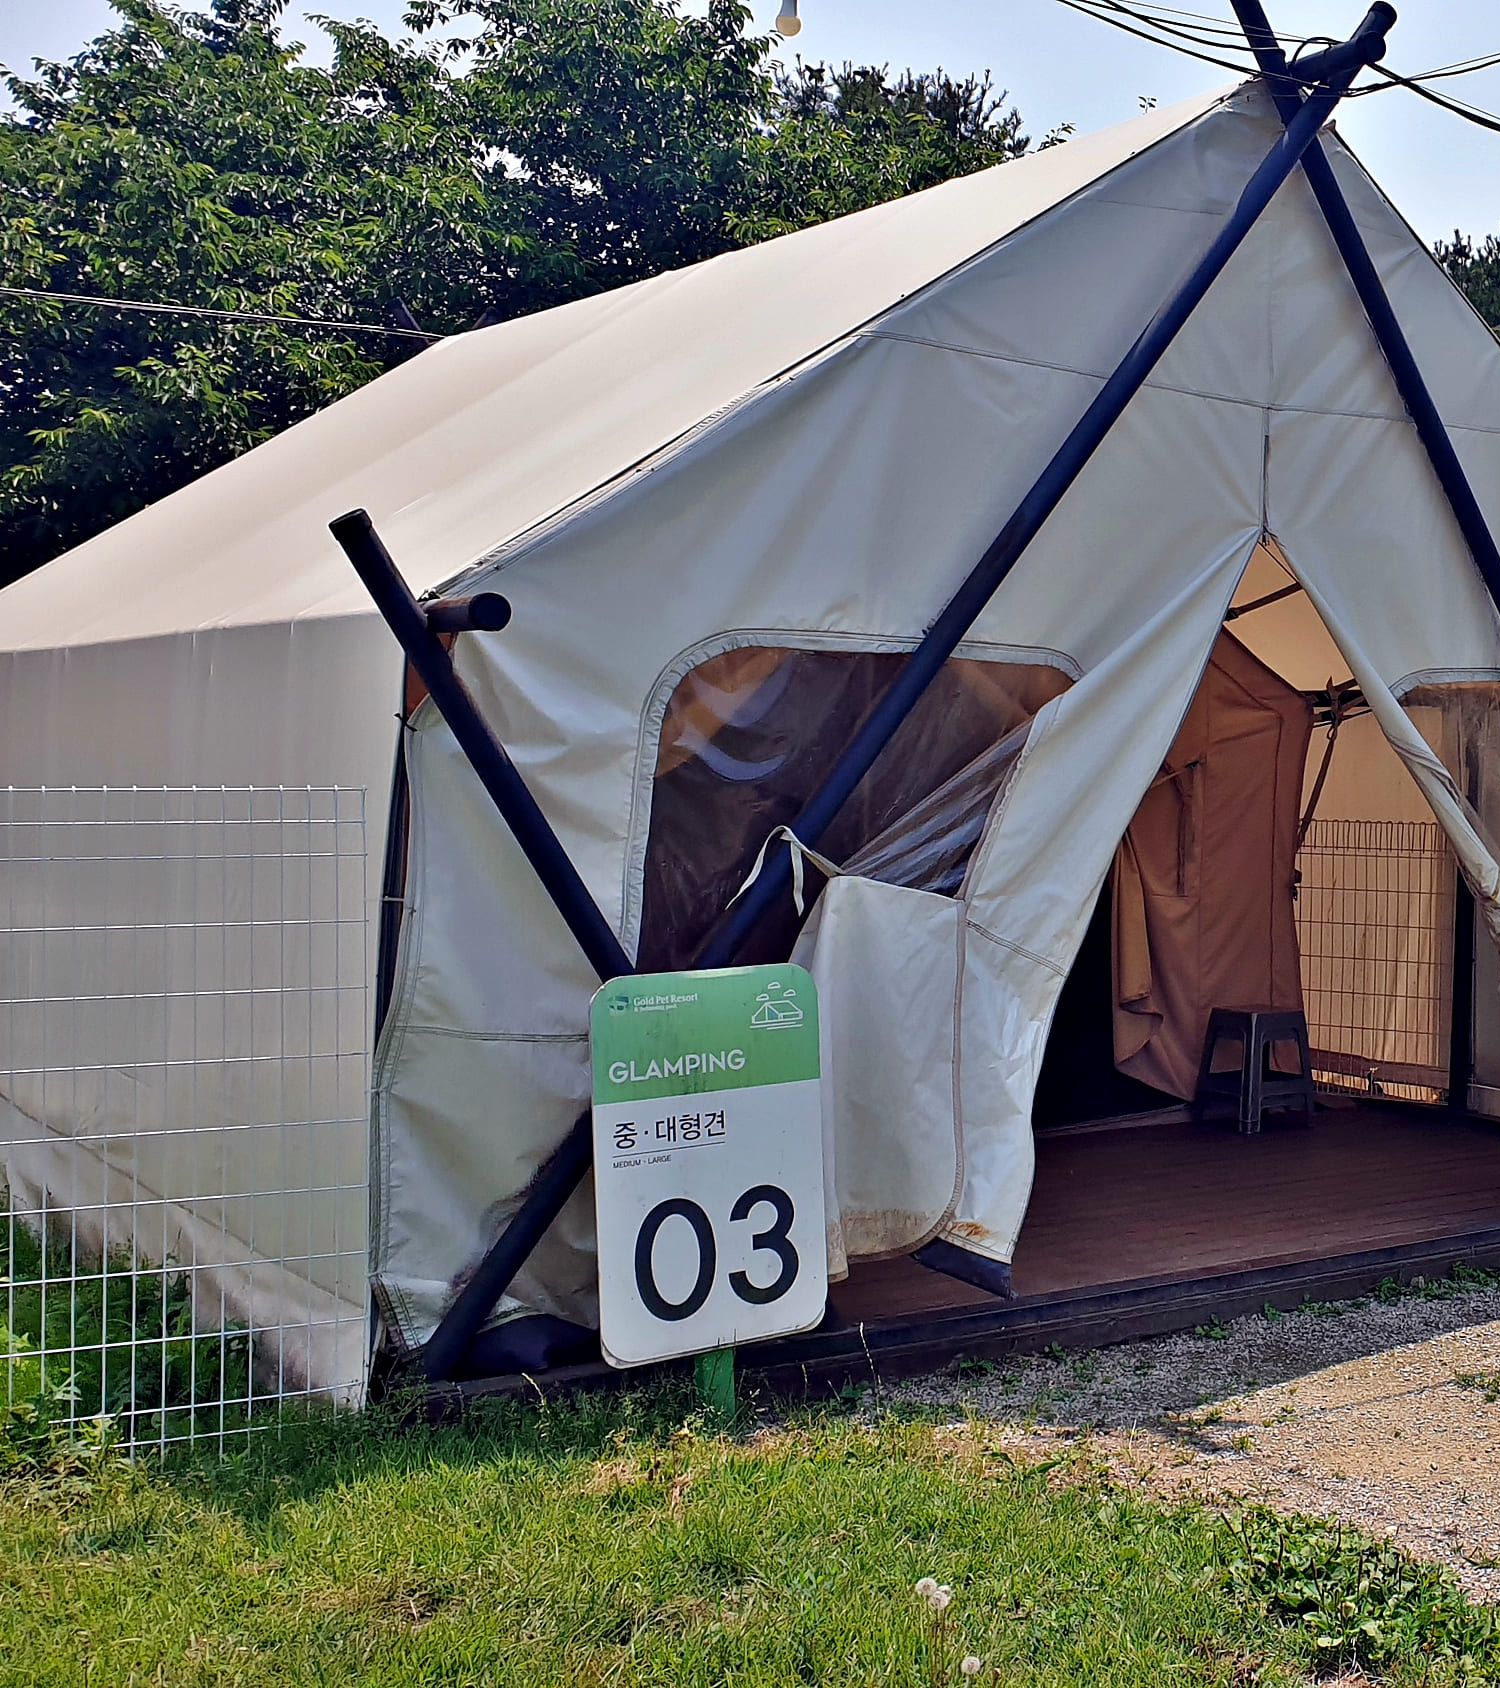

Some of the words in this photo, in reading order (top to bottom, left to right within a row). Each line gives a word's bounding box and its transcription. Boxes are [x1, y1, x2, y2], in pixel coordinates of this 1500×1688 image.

[633, 996, 655, 1007] Gold
[656, 995, 669, 1004] Pet
[670, 993, 698, 1003] Resort
[608, 1048, 747, 1085] GLAMPING
[648, 1155, 672, 1165] LARGE
[634, 1184, 800, 1322] 03
